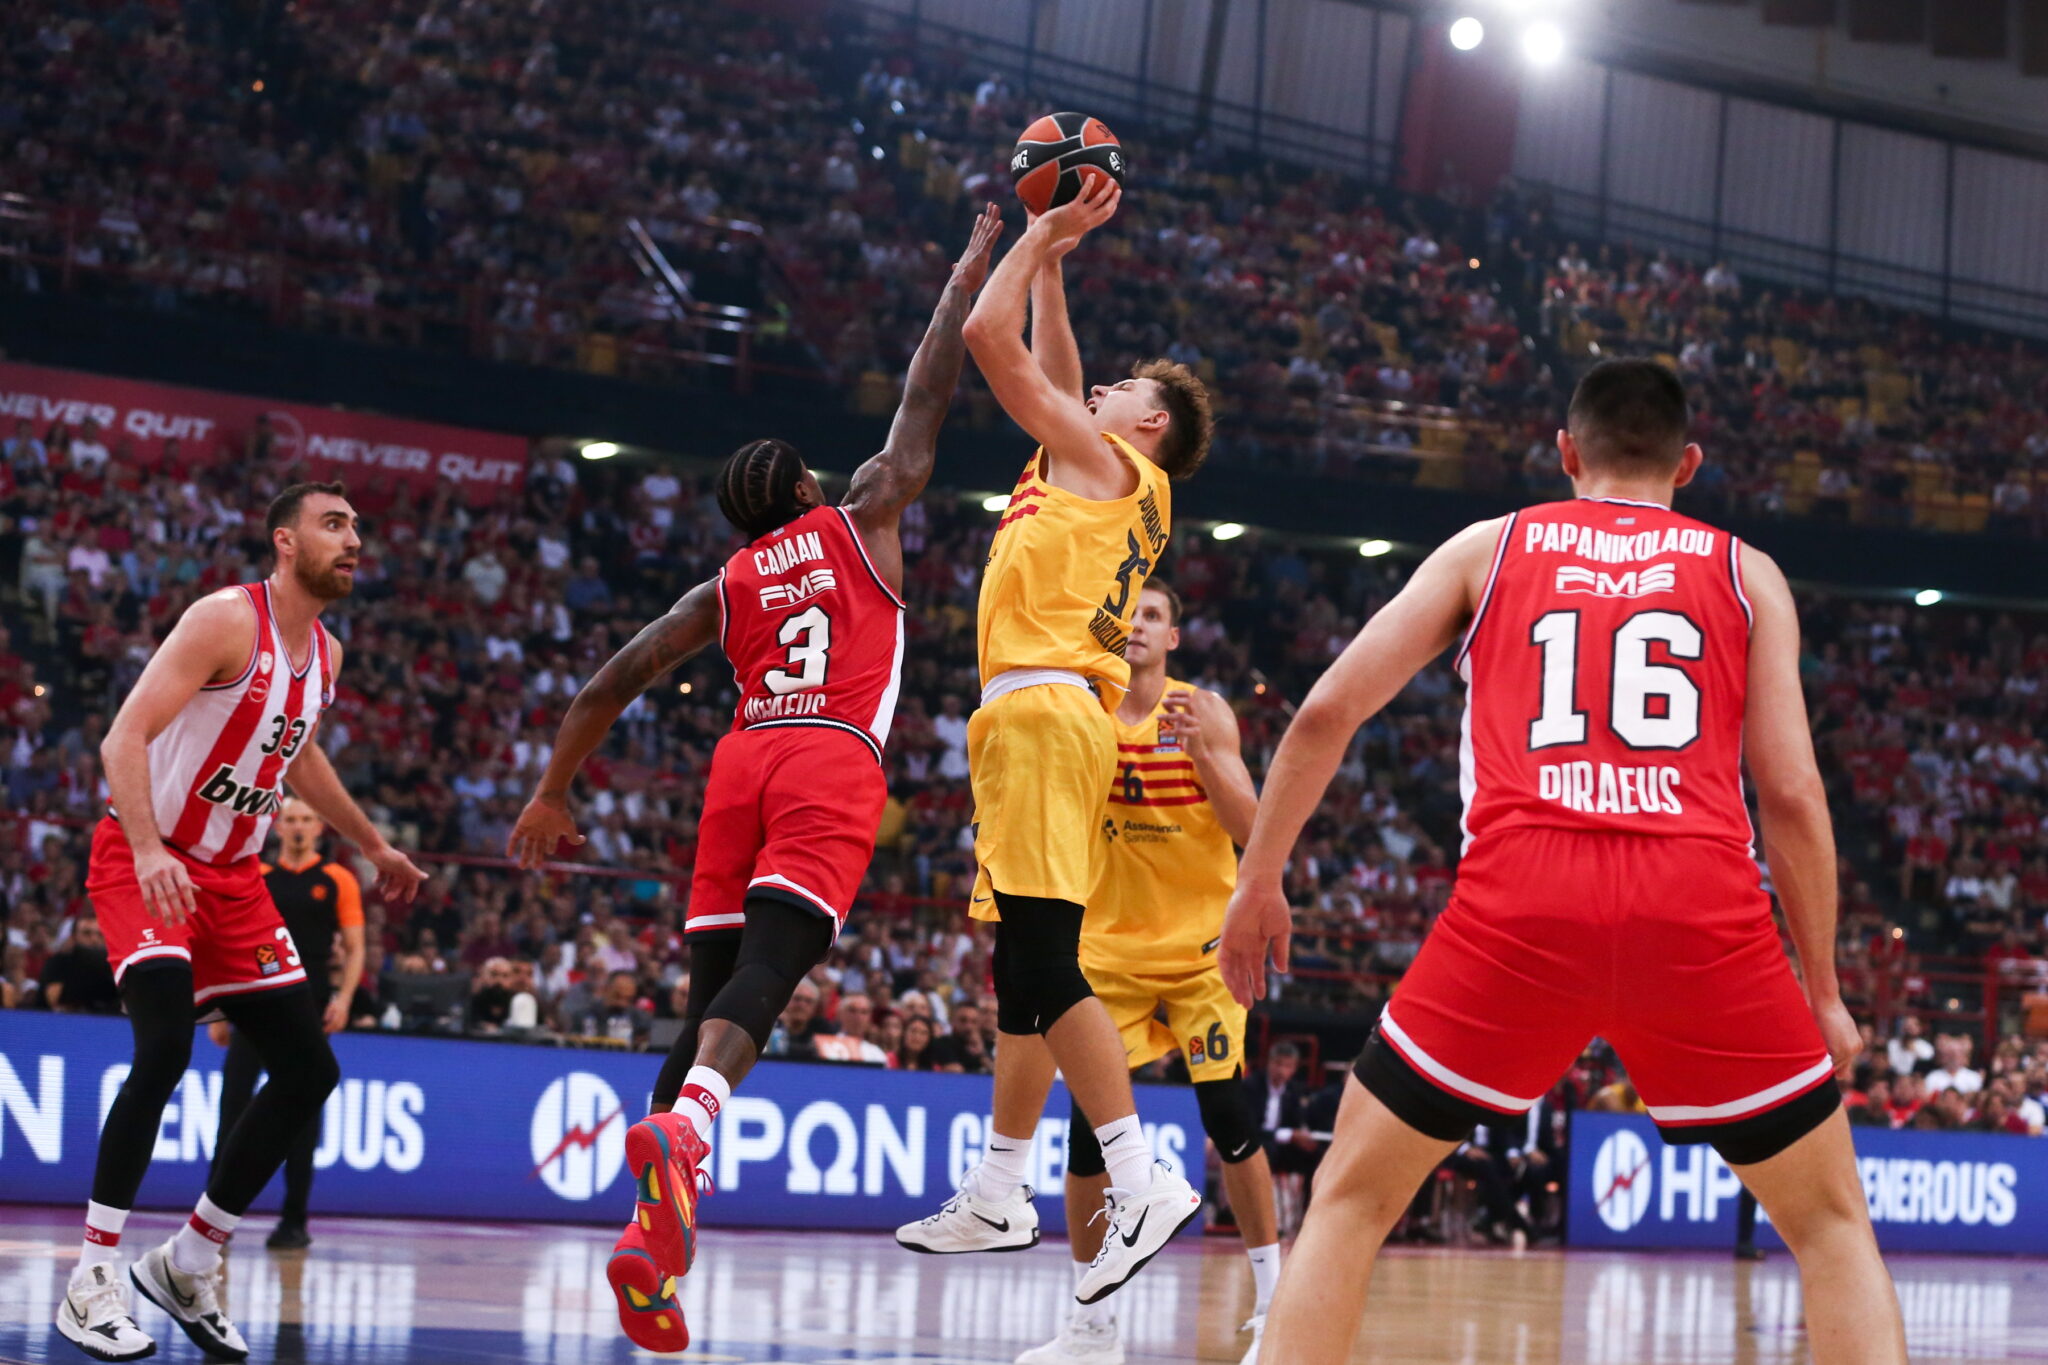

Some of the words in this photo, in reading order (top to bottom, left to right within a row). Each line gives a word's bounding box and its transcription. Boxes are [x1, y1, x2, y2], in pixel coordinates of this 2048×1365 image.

[0, 391, 117, 430] NEVER
[124, 408, 215, 440] QUIT
[306, 434, 431, 472] NEVER
[437, 452, 523, 484] QUIT
[754, 531, 824, 577] CANAAN
[1525, 522, 1714, 564] PAPANIKOLAOU
[759, 568, 837, 611] FMS
[1555, 563, 1676, 598] FMS
[762, 604, 832, 696] 3
[1526, 608, 1704, 751] 16
[261, 714, 307, 758] 33
[197, 764, 281, 815] bwi
[1123, 763, 1144, 804] 6
[1539, 760, 1683, 814] PIRAEUS
[1206, 1021, 1229, 1061] 6
[1855, 1156, 2018, 1227] ENEROUS
